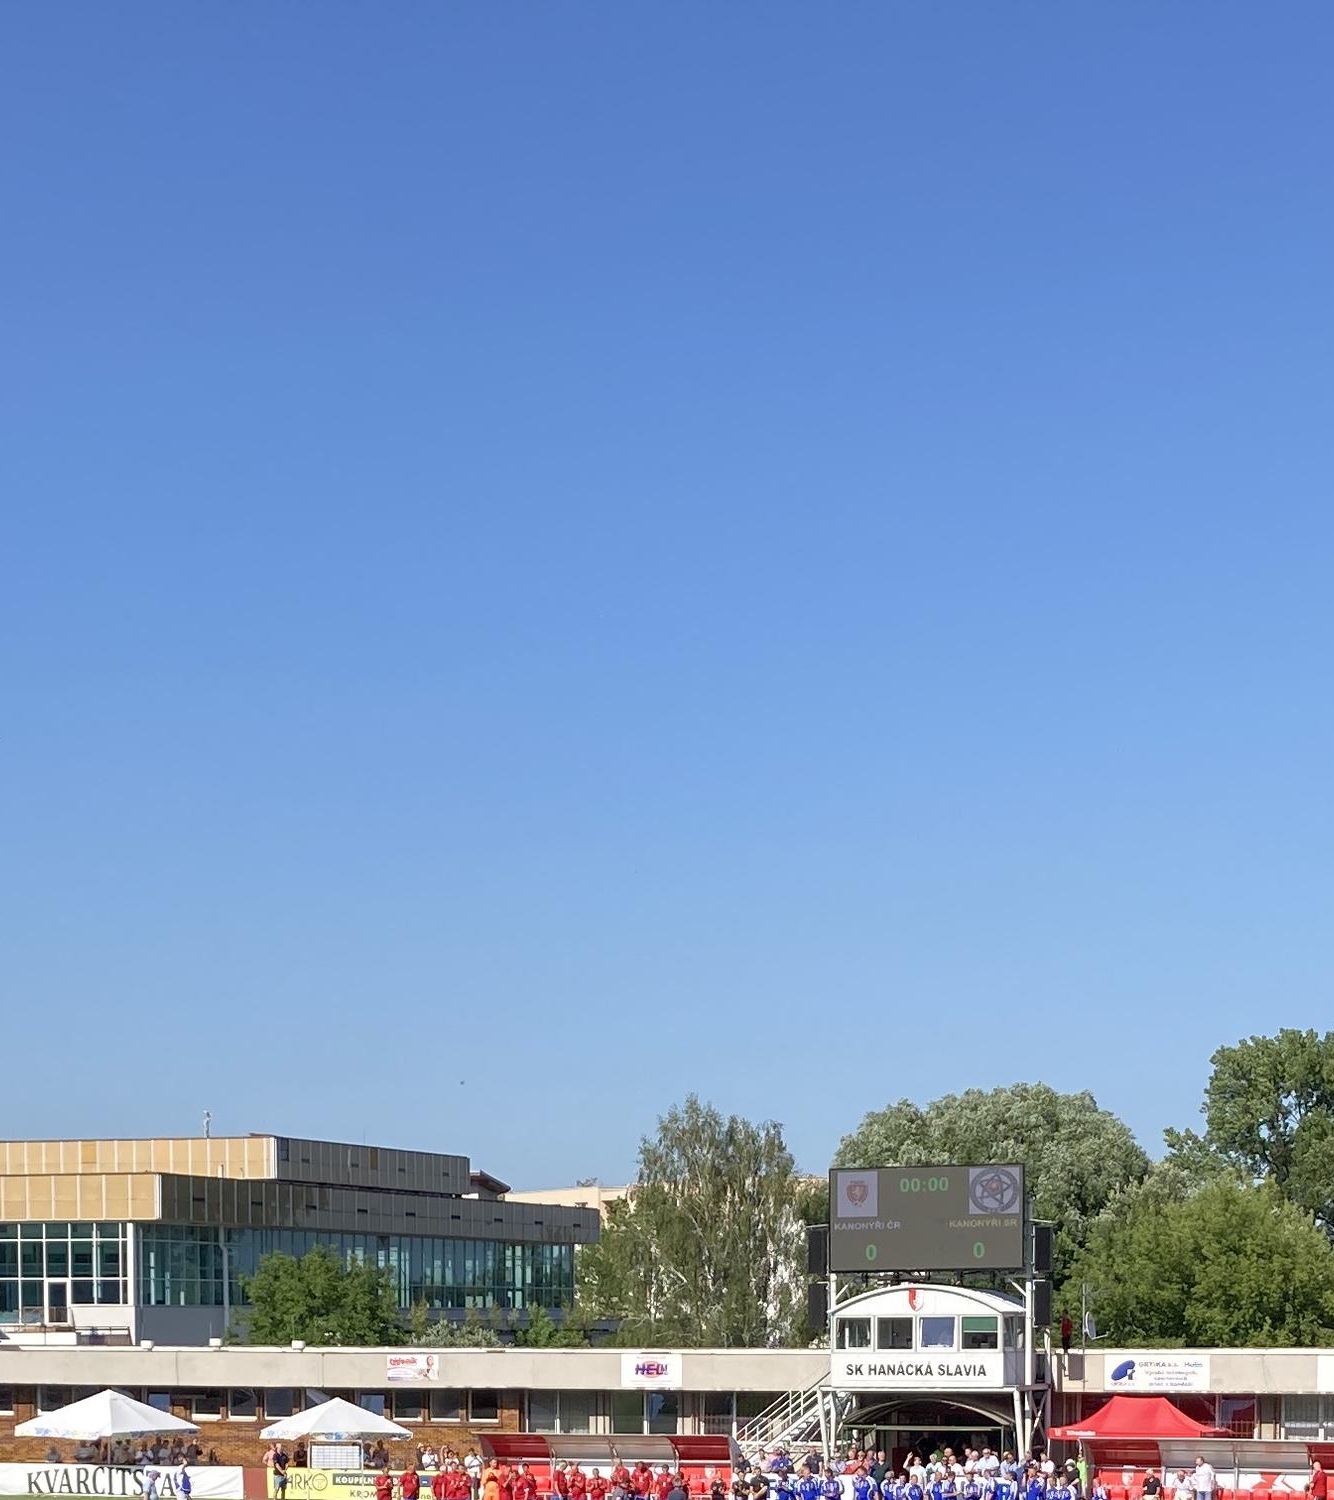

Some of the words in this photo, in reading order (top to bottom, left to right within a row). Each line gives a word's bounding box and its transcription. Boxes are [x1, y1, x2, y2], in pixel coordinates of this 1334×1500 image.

[900, 1177, 949, 1192] 00:00
[866, 1244, 877, 1261] 0
[973, 1241, 985, 1258] 0
[846, 1363, 864, 1376] SK
[868, 1361, 934, 1377] HANÁCKÁ
[937, 1364, 987, 1377] SLAVIA
